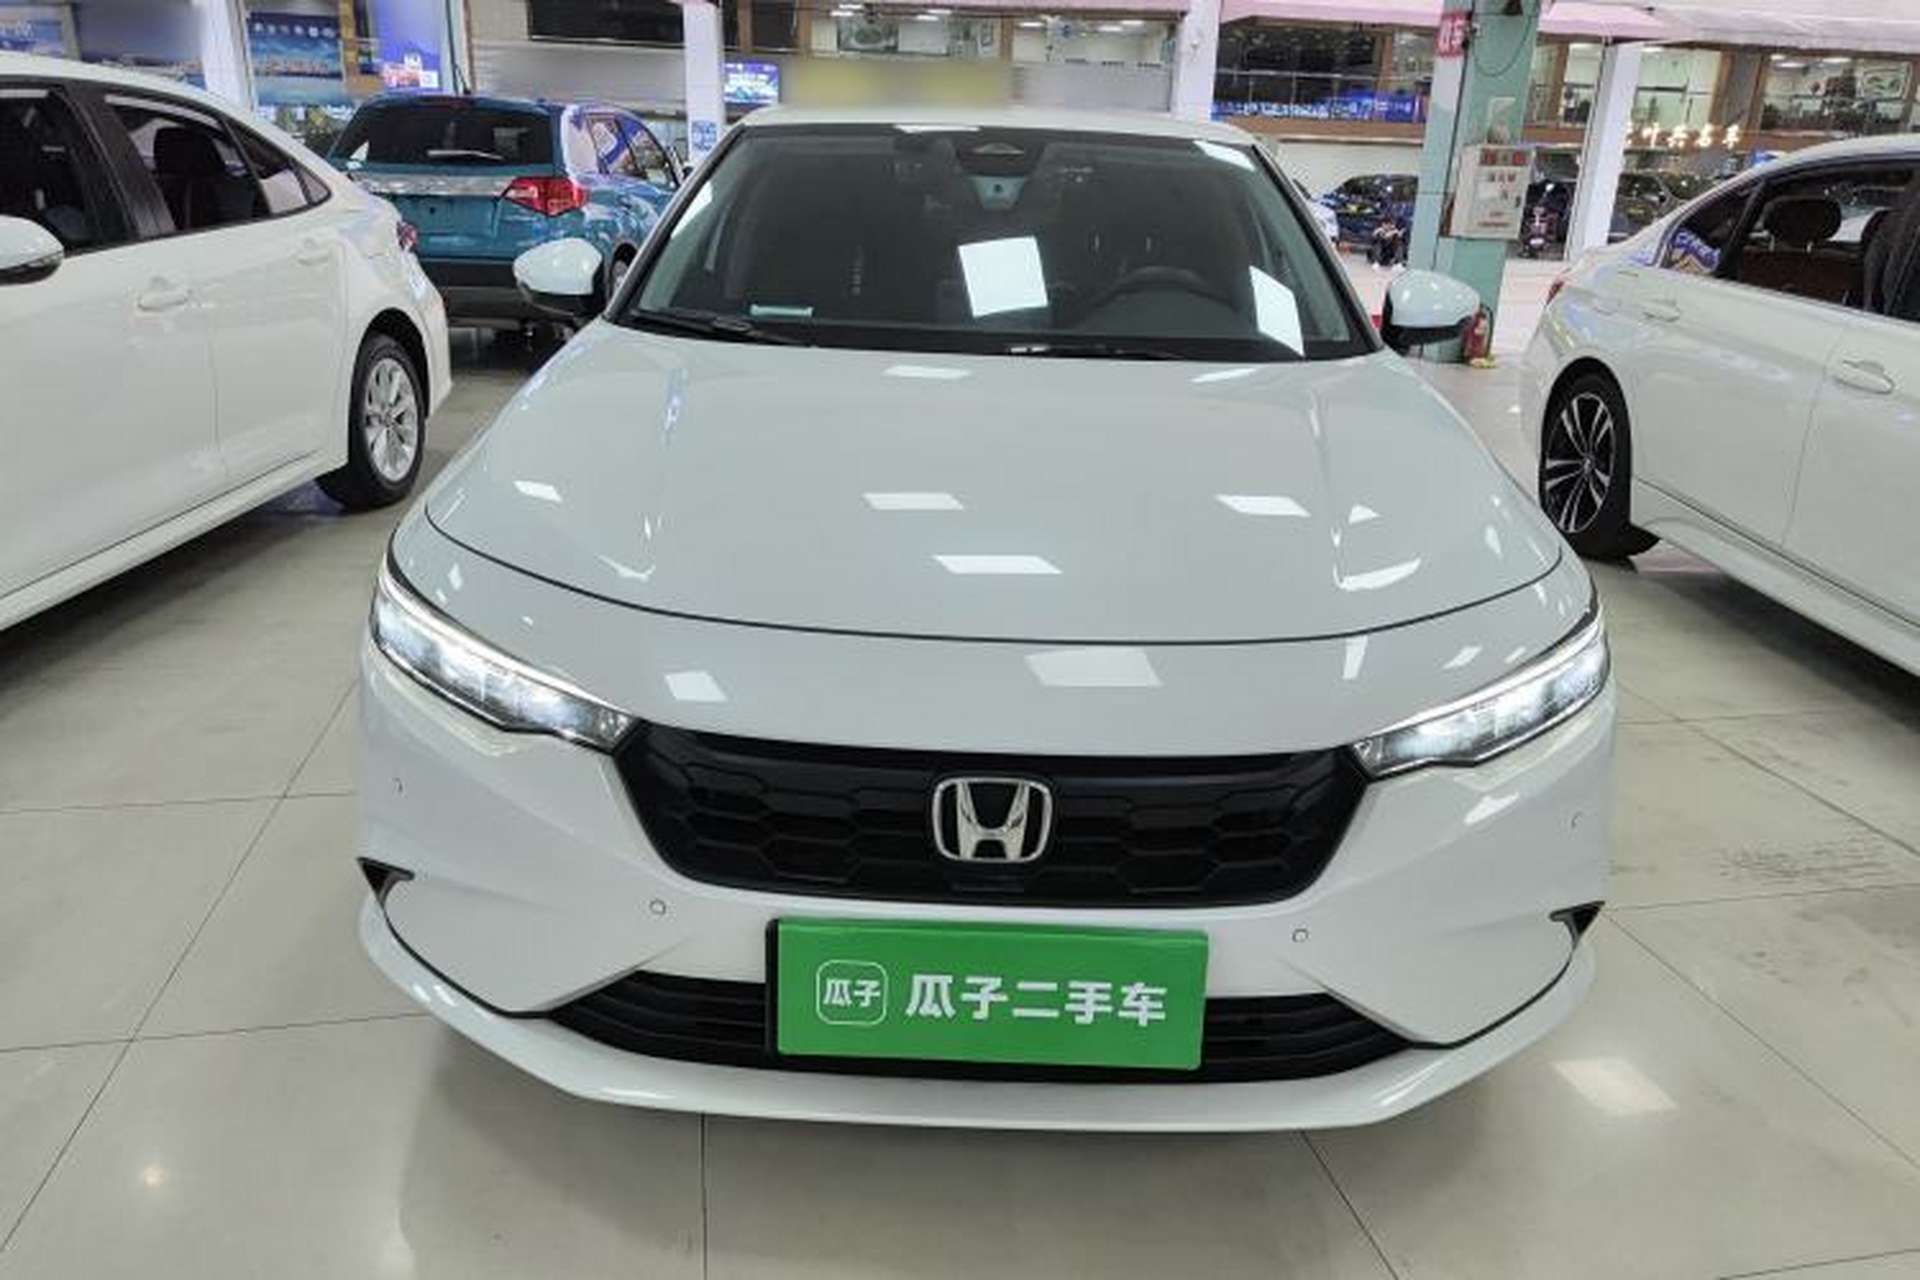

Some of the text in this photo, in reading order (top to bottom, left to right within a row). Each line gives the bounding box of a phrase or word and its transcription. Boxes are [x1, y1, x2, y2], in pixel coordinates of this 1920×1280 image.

[823, 978, 881, 1008] 瓜子
[905, 974, 1168, 1027] 瓜子二手车
